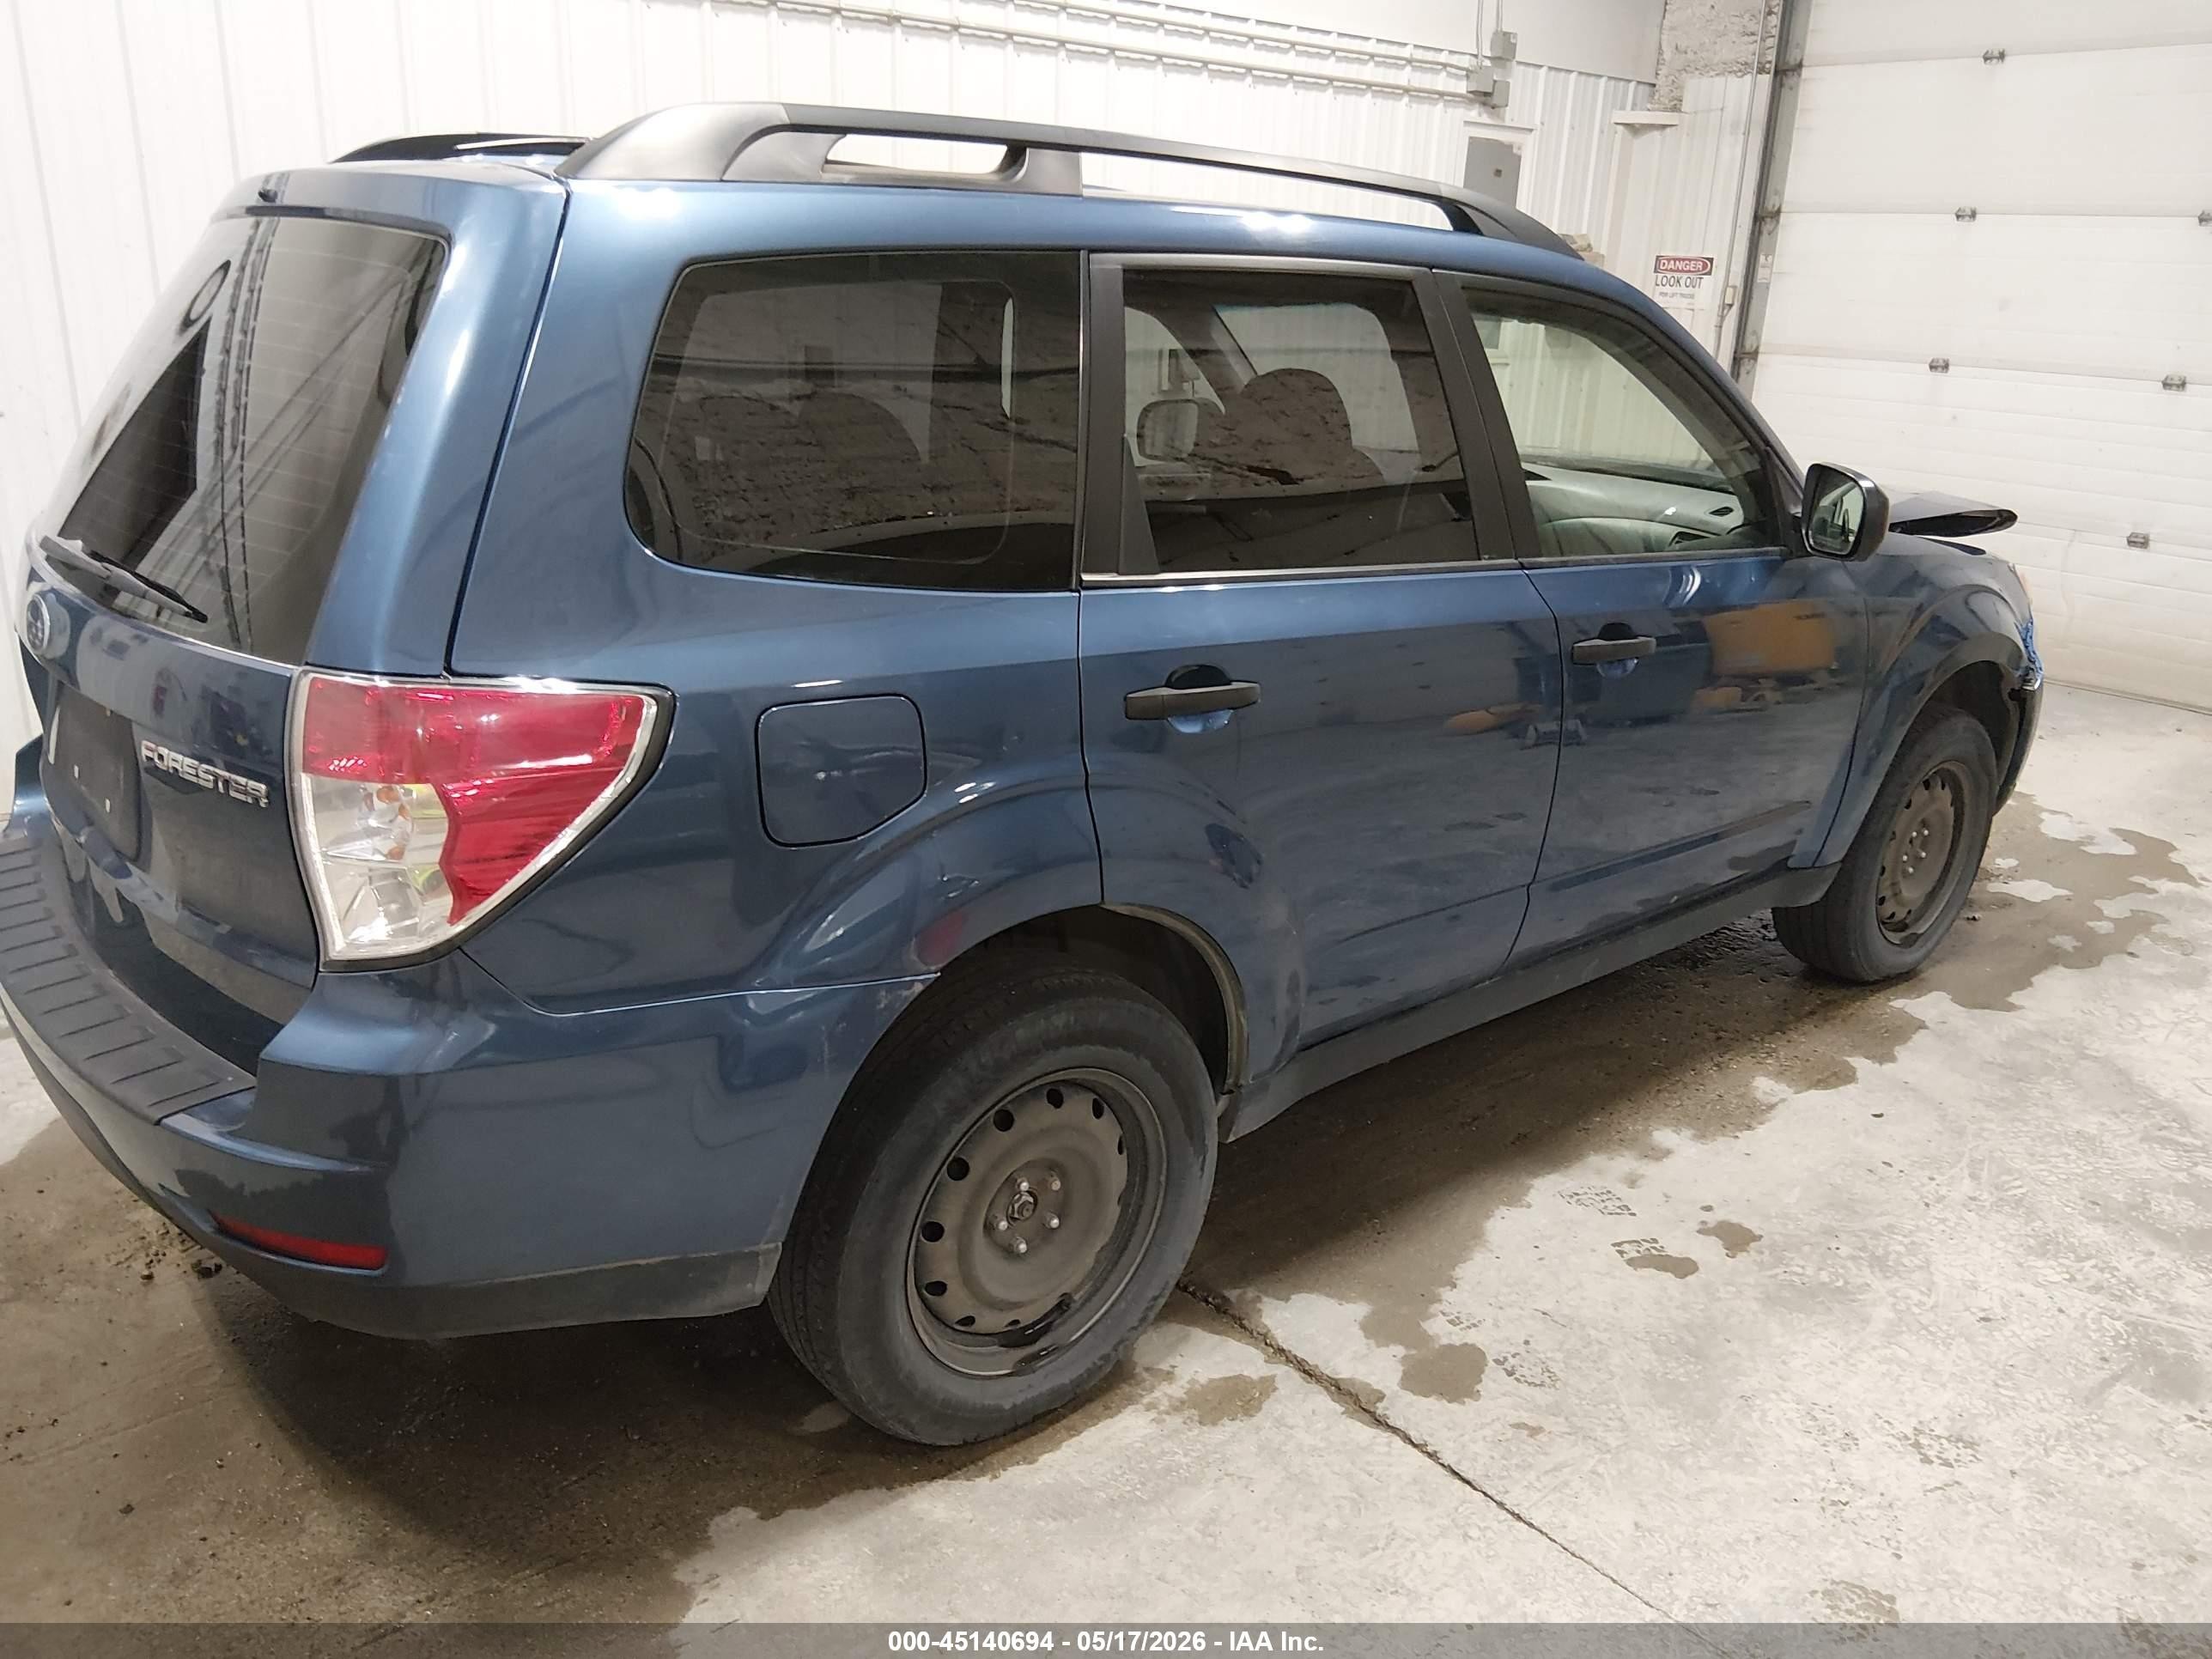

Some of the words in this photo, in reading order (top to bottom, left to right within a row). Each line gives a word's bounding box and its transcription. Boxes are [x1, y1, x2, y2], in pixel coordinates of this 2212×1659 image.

[1660, 259, 1703, 270] DANGER
[1656, 275, 1682, 288] LOOK
[1685, 276, 1704, 289] OUT
[141, 739, 269, 808] FORESTER
